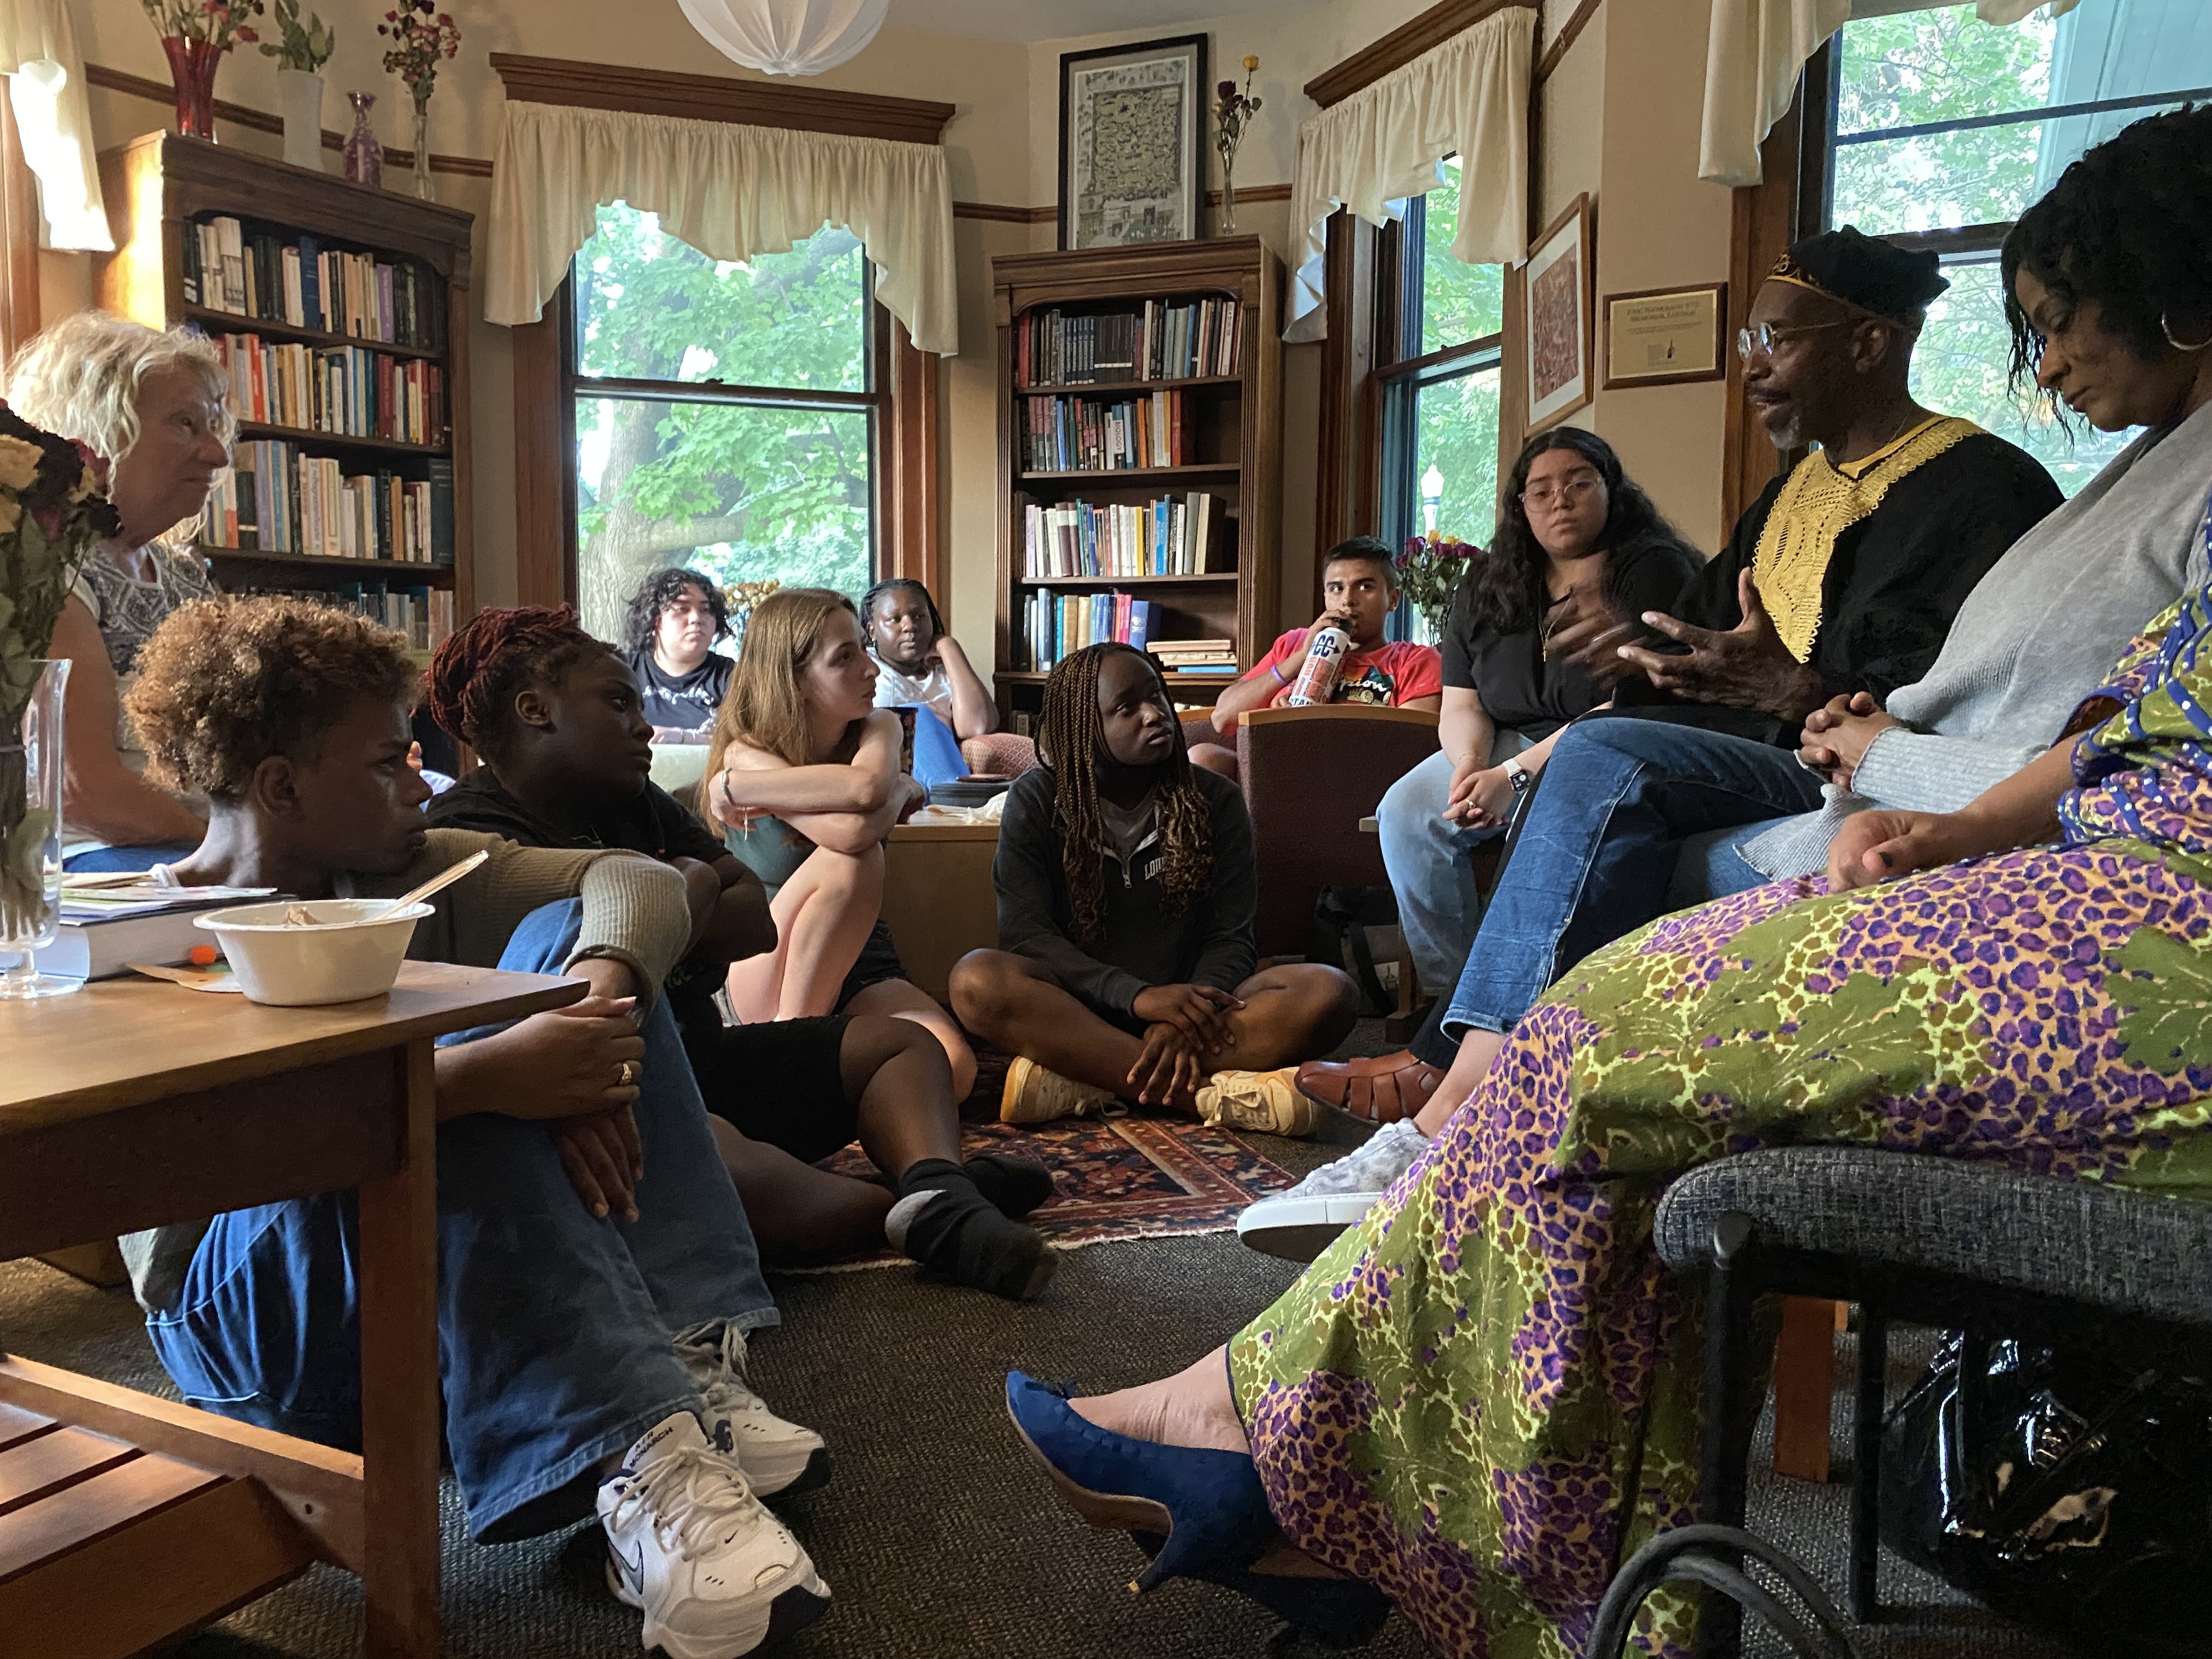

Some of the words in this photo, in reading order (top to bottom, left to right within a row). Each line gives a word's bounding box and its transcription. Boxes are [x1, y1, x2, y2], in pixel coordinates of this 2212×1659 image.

[1338, 678, 1387, 692] pion
[629, 1426, 673, 1468] MONARCH
[635, 1431, 653, 1452] AIR
